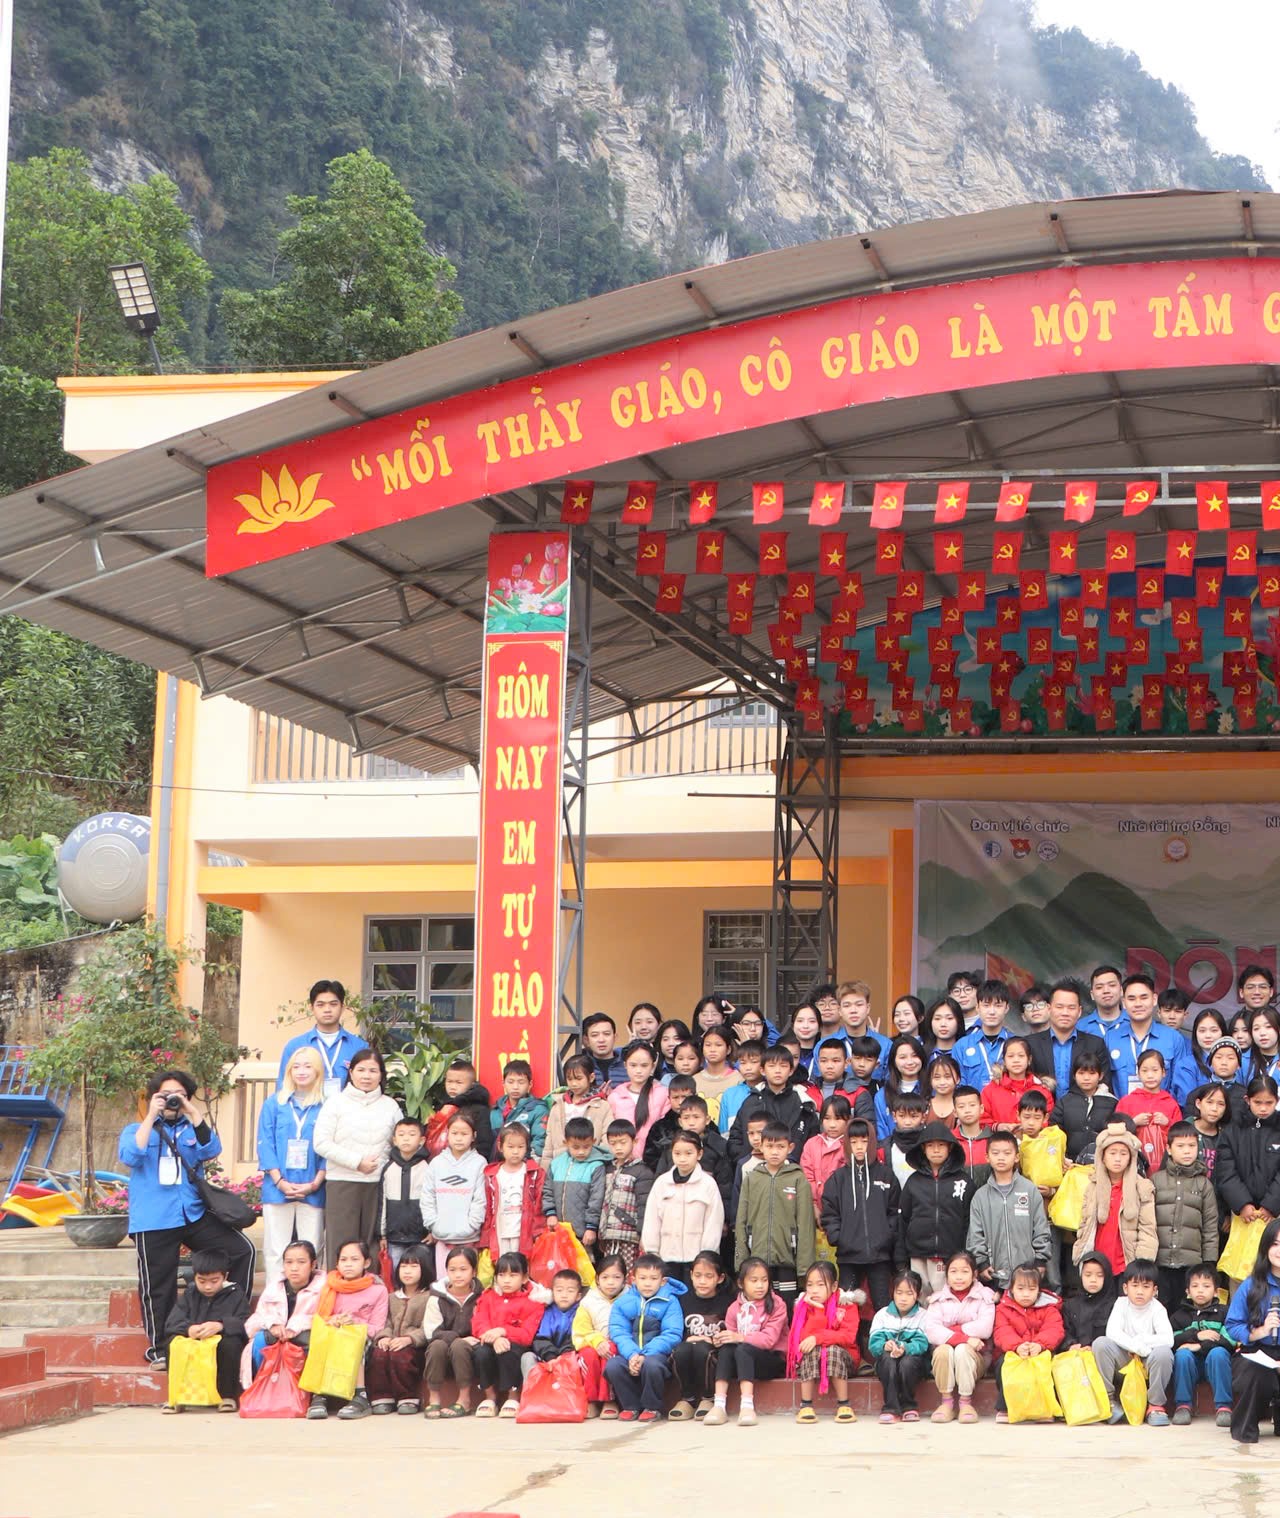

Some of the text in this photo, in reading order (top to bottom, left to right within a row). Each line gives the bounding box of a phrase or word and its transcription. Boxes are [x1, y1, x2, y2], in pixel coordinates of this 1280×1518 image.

[476, 387, 584, 465] THẦY
[609, 361, 723, 429] GIÁO,
[738, 335, 793, 397] CÔ
[820, 314, 921, 379] GIÁO
[947, 303, 1004, 359] LÀ
[1030, 288, 1117, 356] MỘT
[1148, 271, 1234, 339] TẤM
[496, 660, 549, 719] HÔM
[494, 744, 549, 791] NAY
[502, 819, 537, 865] EM
[971, 819, 999, 832] Đơn
[1001, 819, 1015, 834] vị
[1034, 819, 1070, 832] chức
[1119, 819, 1148, 832] Nhà
[1150, 819, 1169, 832] tài
[1171, 819, 1190, 835] trợ
[500, 884, 537, 951] TỰ
[491, 958, 544, 1018] HÀO
